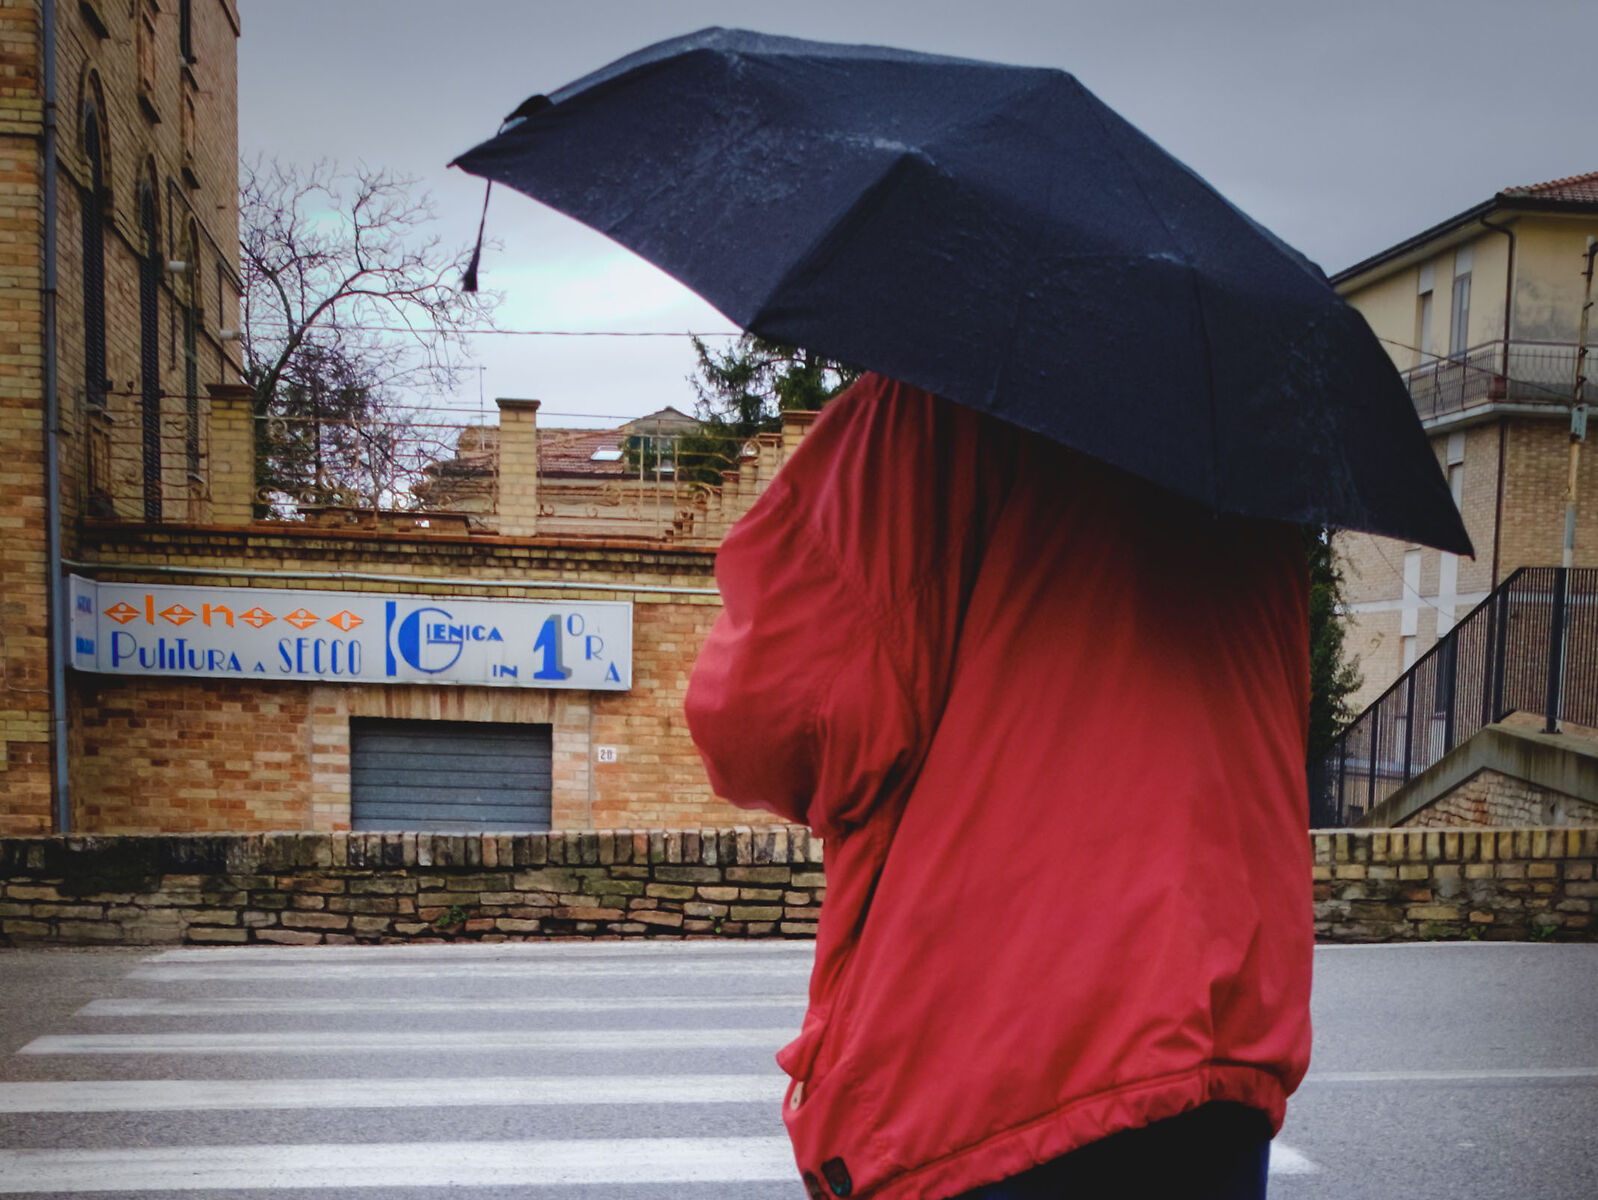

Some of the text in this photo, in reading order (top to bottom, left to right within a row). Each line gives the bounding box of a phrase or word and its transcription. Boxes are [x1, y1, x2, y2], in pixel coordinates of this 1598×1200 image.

[278, 637, 362, 676] SECCO
[493, 664, 518, 678] IN
[533, 614, 573, 681] 1
